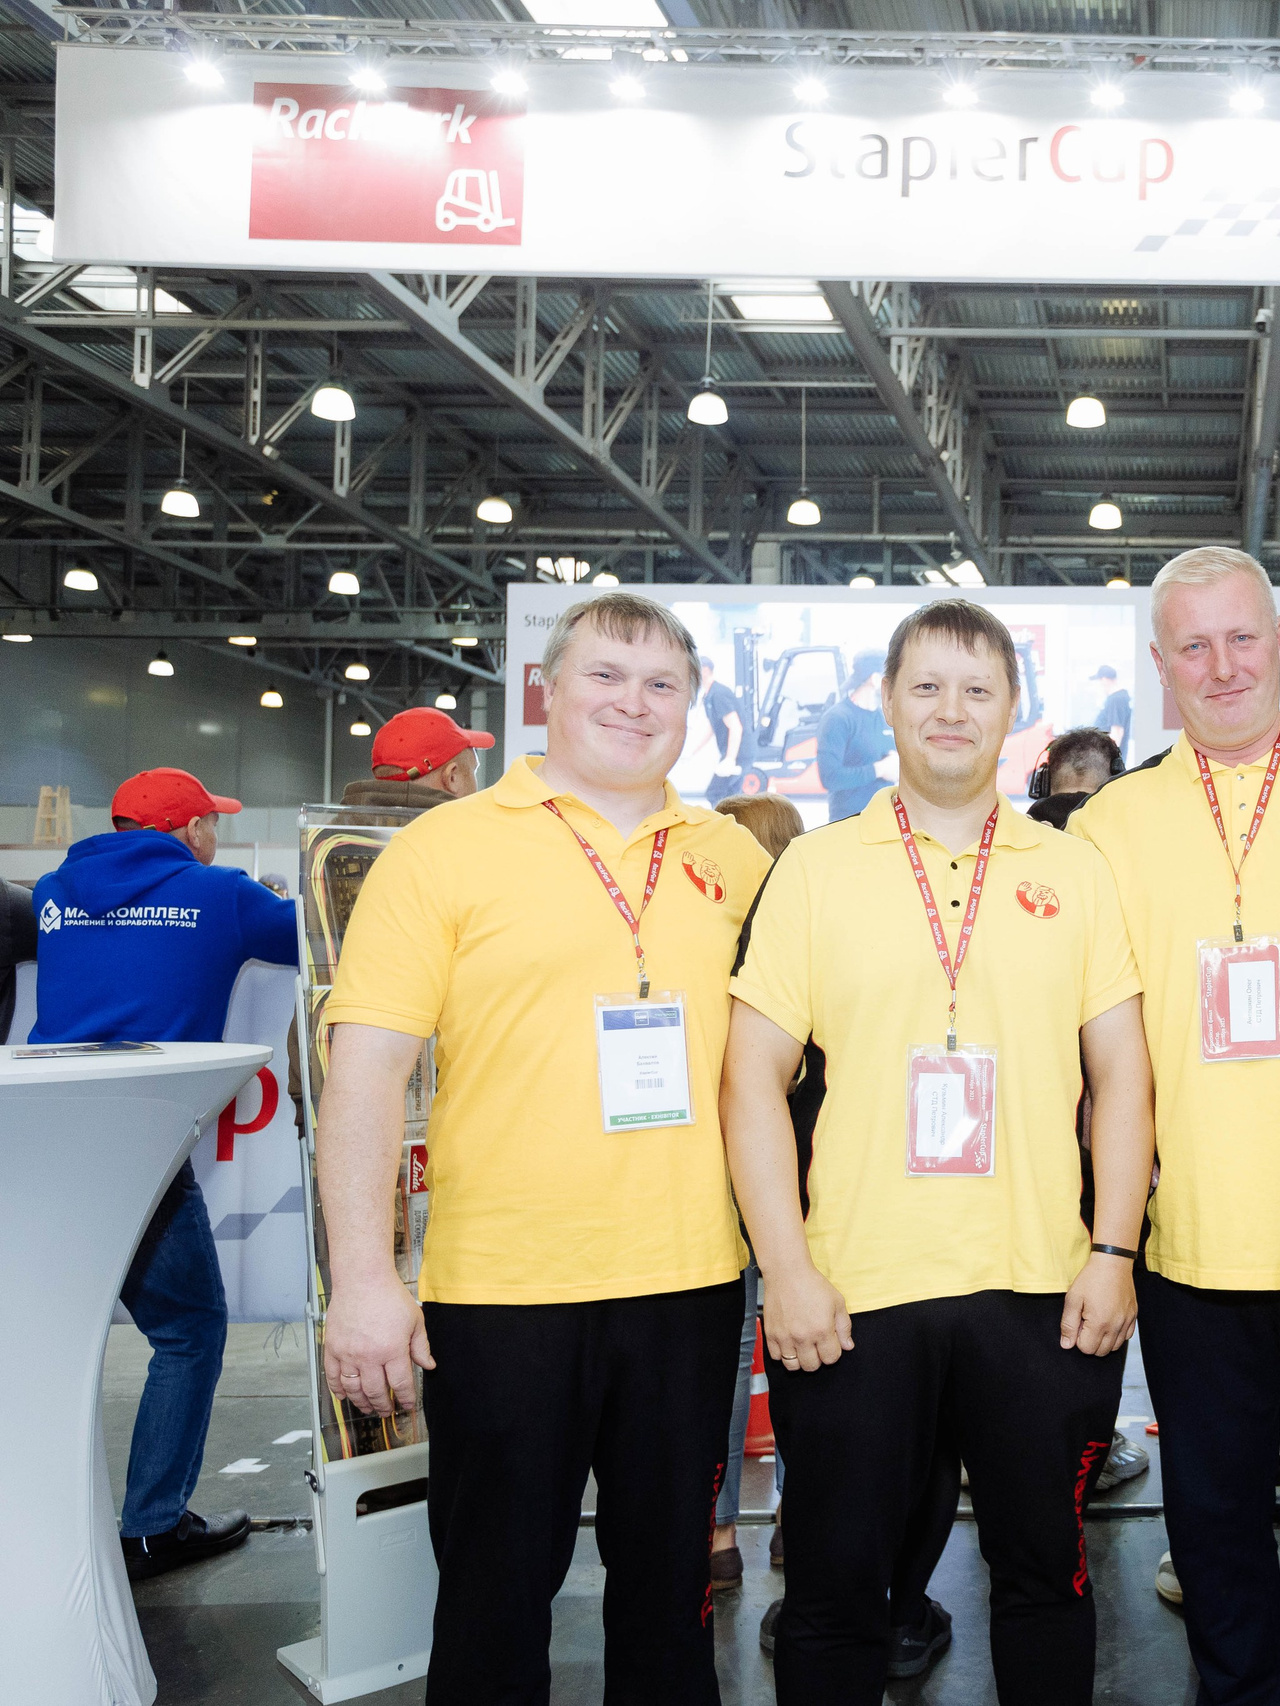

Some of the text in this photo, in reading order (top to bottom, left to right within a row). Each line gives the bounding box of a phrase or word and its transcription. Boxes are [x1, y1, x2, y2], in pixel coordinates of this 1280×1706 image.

[908, 845, 918, 866] RackFork
[594, 862, 612, 883] RackFork
[975, 860, 985, 881] RackFork
[920, 883, 931, 904] RackFork
[64, 907, 201, 920] МАКОМПЛЕКТ
[619, 901, 635, 924] RackFork
[967, 898, 977, 920] RackFork
[932, 922, 943, 945] RackFork
[956, 939, 967, 963] RackFork
[979, 1122, 988, 1156] StaplerCup
[411, 1153, 425, 1192] Linde
